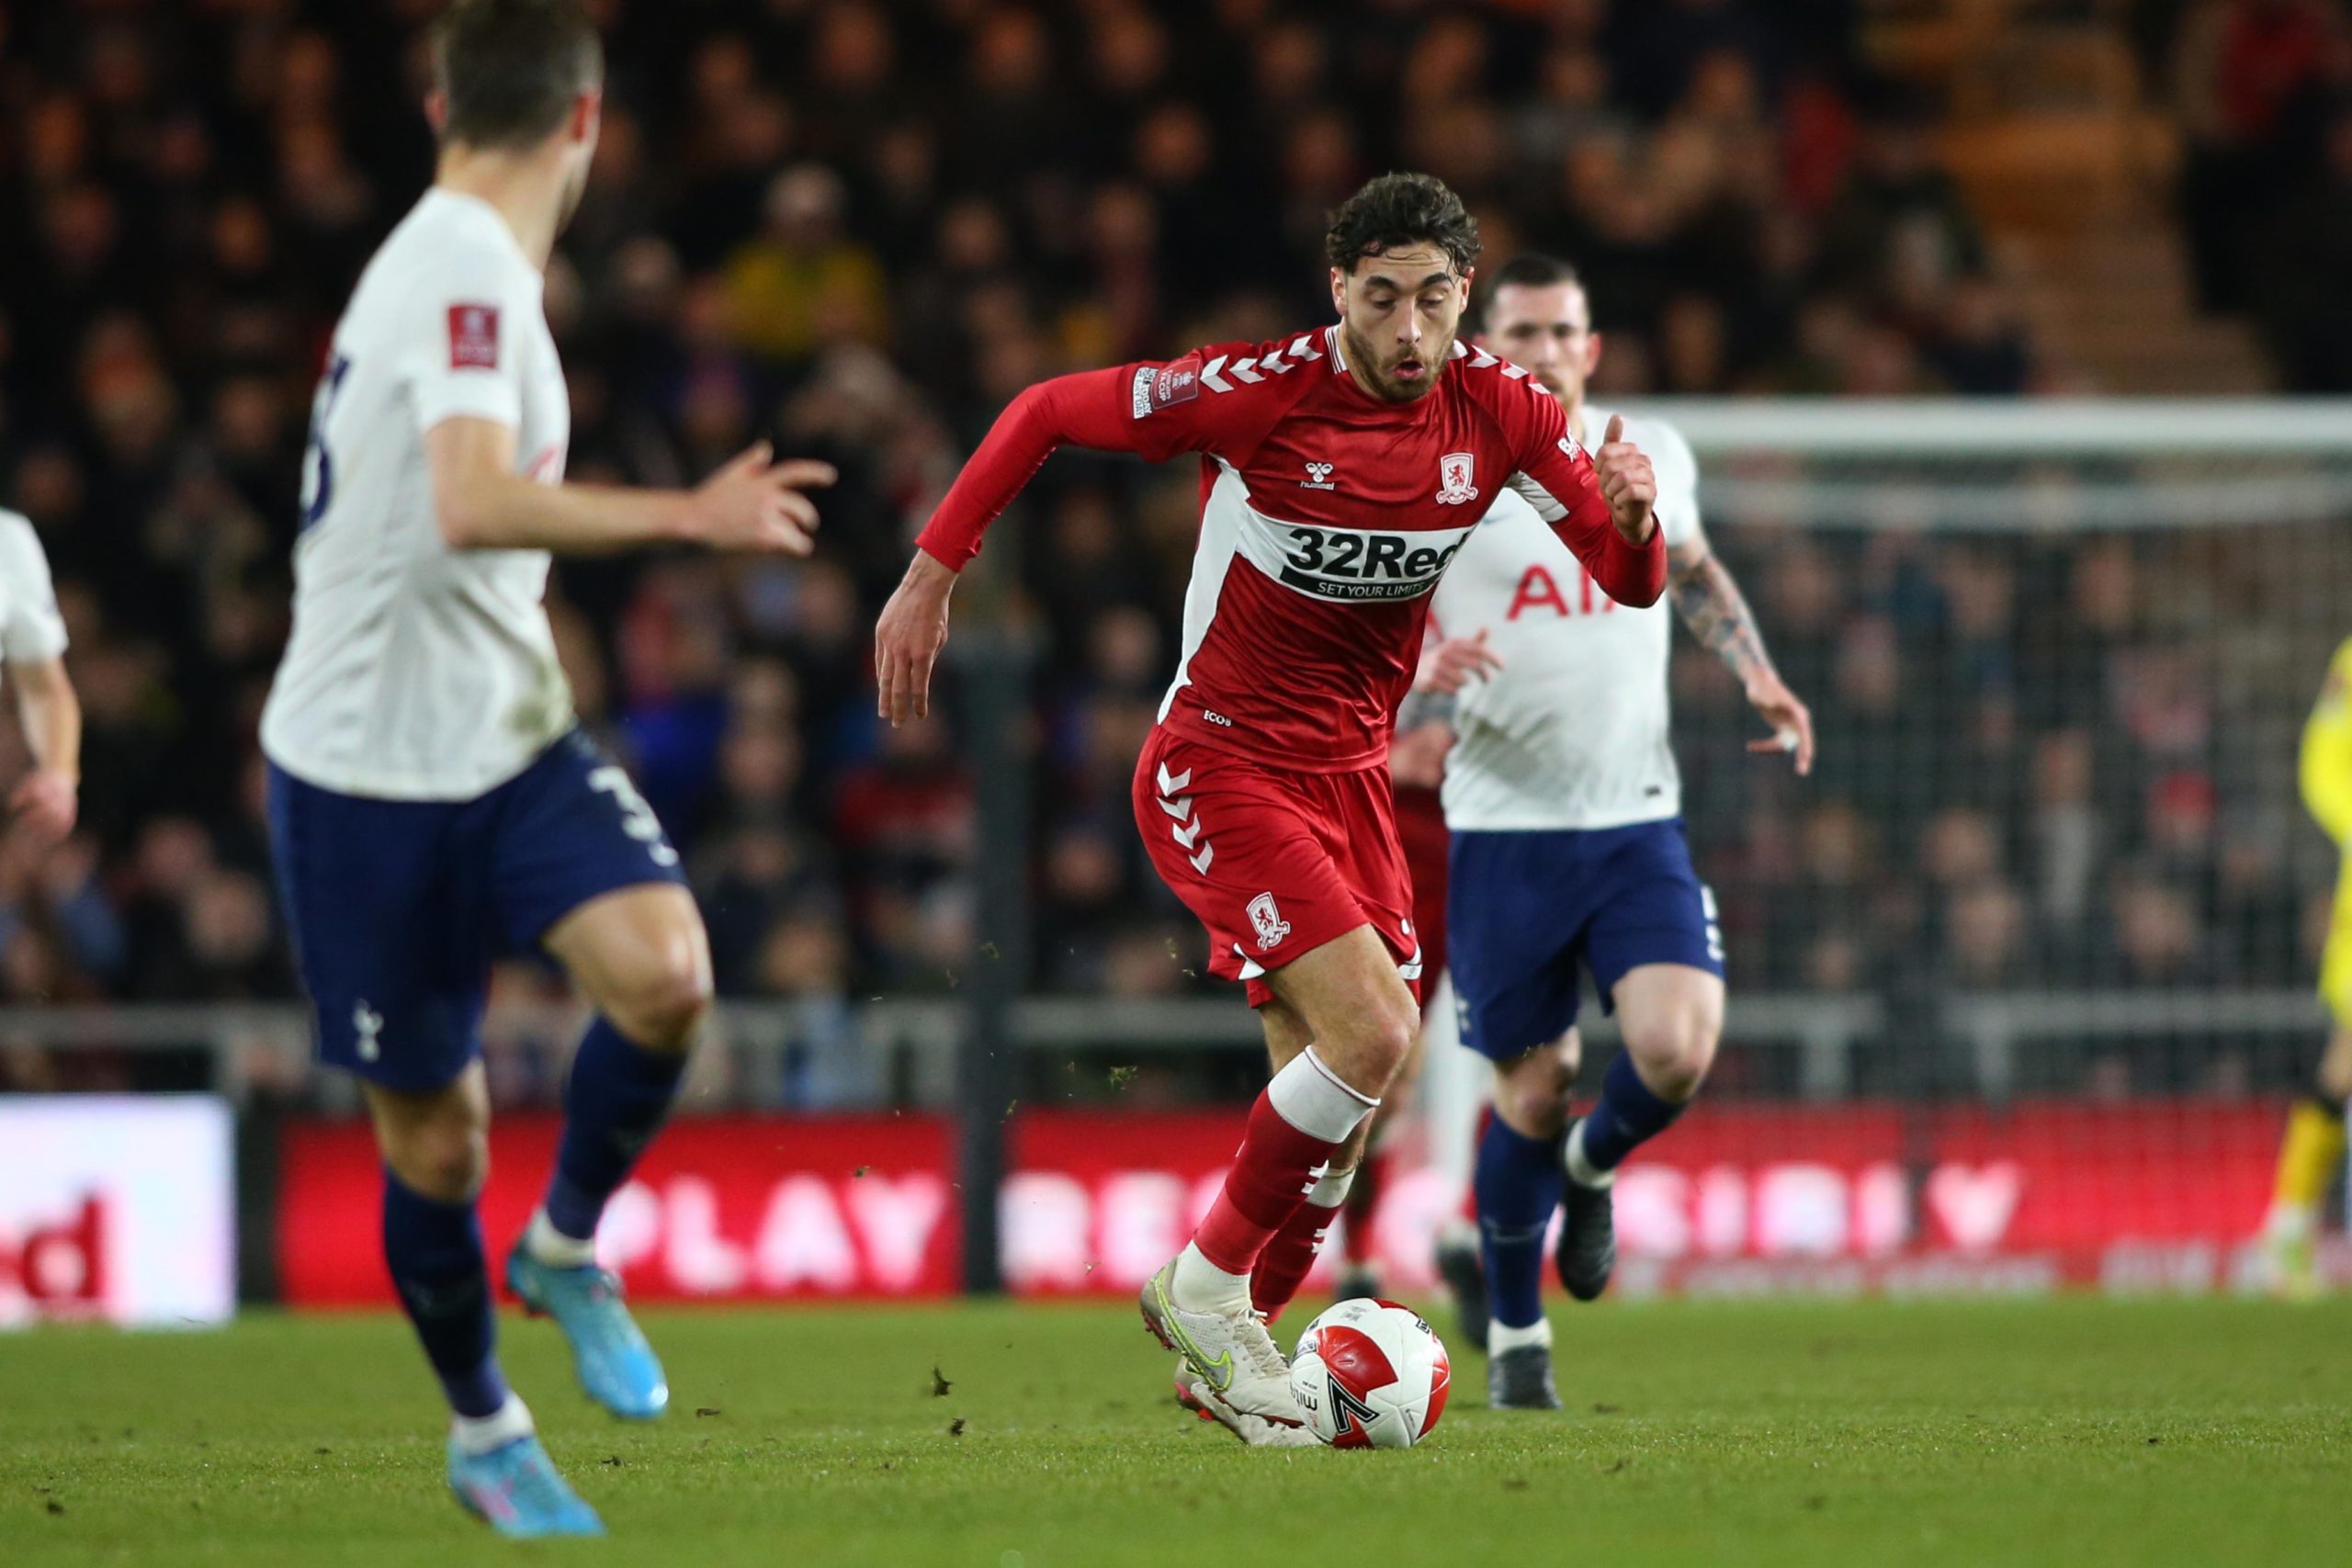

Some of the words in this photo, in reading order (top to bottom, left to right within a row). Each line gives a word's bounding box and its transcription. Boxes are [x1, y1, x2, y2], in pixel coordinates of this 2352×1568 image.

[1142, 383, 1152, 413] TODAY
[1300, 480, 1335, 491] hummel
[1317, 581, 1346, 595] SET
[1347, 584, 1384, 597] YOUR
[1386, 581, 1425, 596] LIMITS
